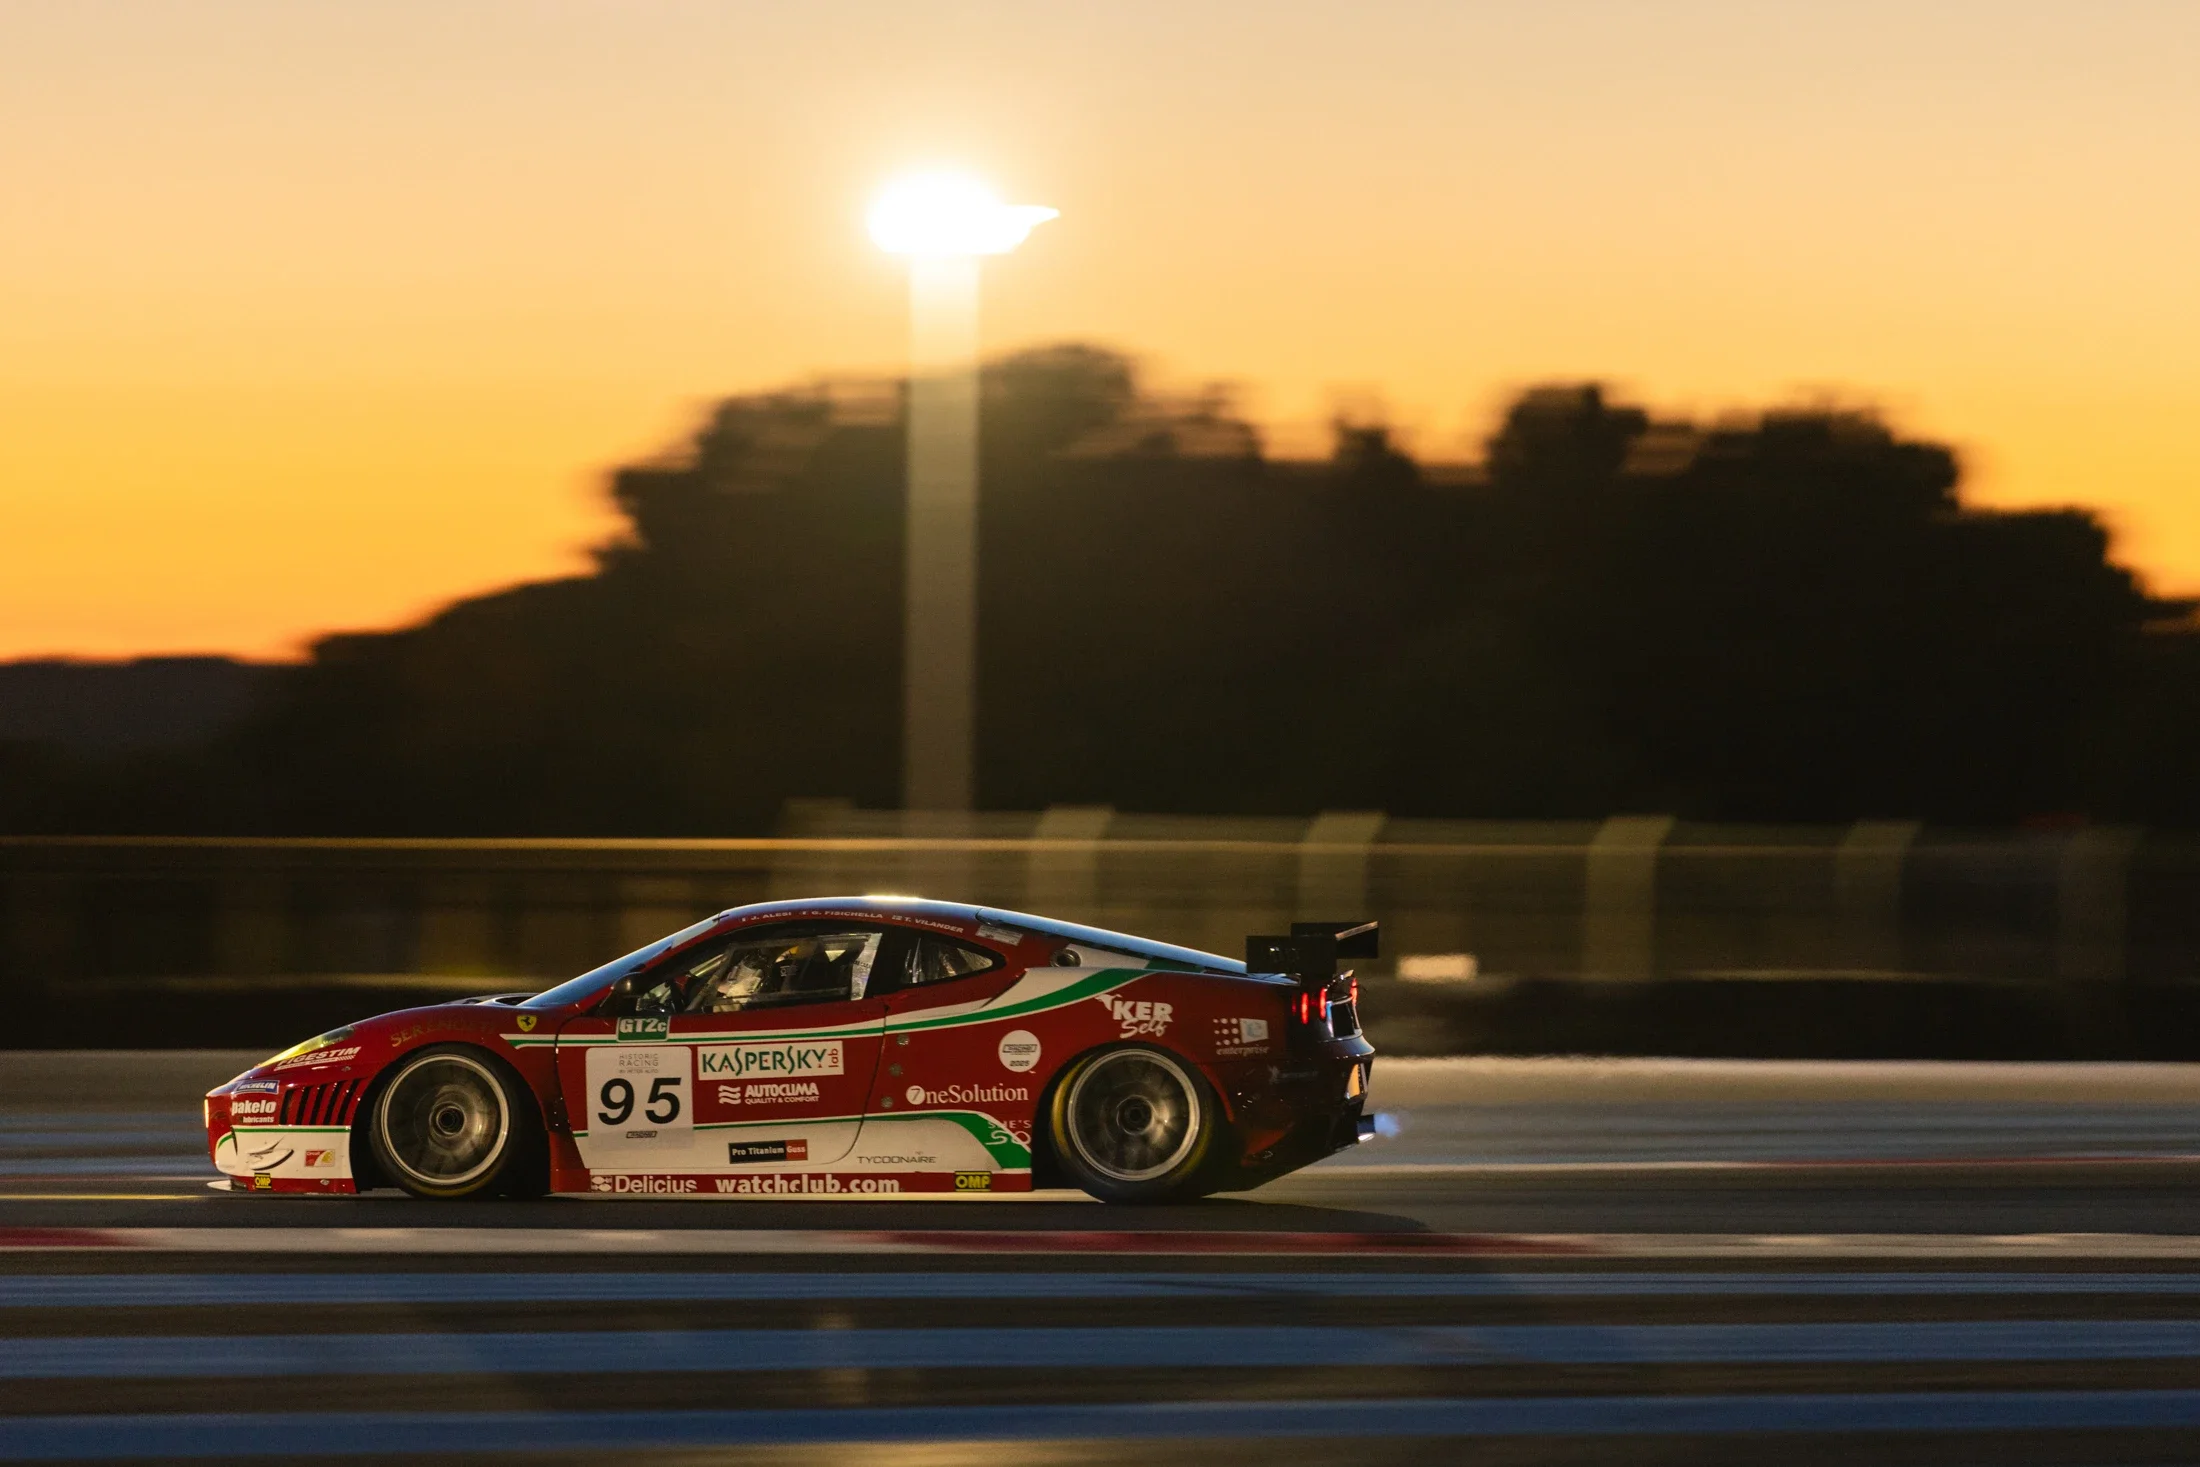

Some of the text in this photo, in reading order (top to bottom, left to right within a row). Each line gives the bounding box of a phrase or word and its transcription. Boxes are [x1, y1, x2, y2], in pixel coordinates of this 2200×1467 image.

[762, 911, 792, 919] ALESI
[824, 910, 883, 919] FISICHELLA
[914, 918, 964, 934] VILANDER
[1112, 1000, 1173, 1023] KER
[619, 1017, 668, 1033] GT2c
[1119, 1017, 1168, 1039] Self
[702, 1045, 828, 1077] KASPERSKY
[828, 1048, 840, 1068] lab
[239, 1082, 276, 1090] MICHELIN
[744, 1082, 820, 1098] AUTOCLIMA
[231, 1099, 277, 1116] pakelo
[597, 1077, 682, 1126] 95
[745, 1097, 777, 1105] QUALITY
[784, 1095, 820, 1103] COMFORT
[242, 1116, 275, 1124] lubricants
[732, 1147, 746, 1156] Pro
[748, 1146, 785, 1155] Titanium
[856, 1155, 937, 1164] TYCOONAIRE
[254, 1176, 272, 1186] OMP
[615, 1175, 698, 1194] Delicius
[714, 1173, 901, 1194] watchclub.com
[955, 1175, 991, 1189] OMP
